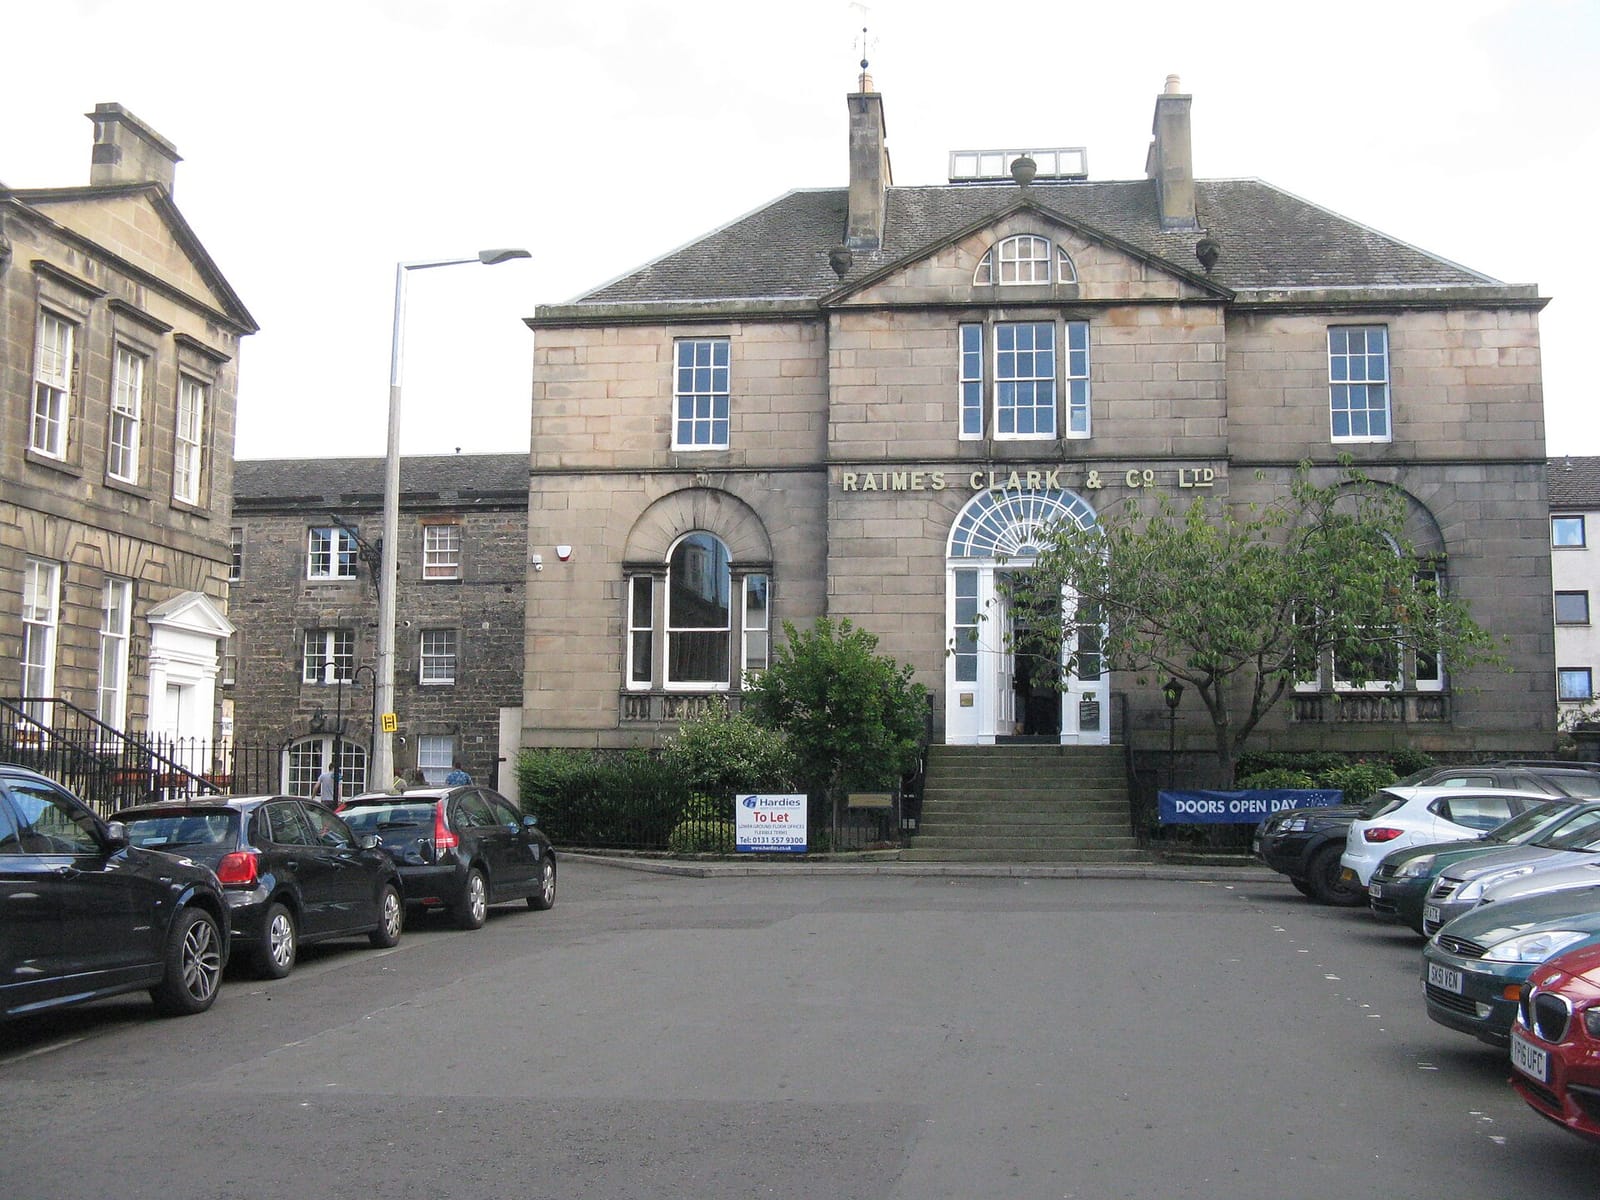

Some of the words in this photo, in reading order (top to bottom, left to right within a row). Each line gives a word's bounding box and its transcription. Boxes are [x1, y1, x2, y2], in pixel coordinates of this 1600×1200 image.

[843, 471, 946, 491] RAIMES
[969, 470, 1060, 491] CLARK
[1086, 470, 1101, 489] &
[759, 798, 801, 807] Hardies
[1175, 800, 1225, 813] DOORS
[1229, 799, 1267, 813] OPEN
[1271, 799, 1298, 813] DAY
[753, 811, 767, 822] To
[770, 811, 789, 822] Let
[1527, 1047, 1543, 1075] UFC
